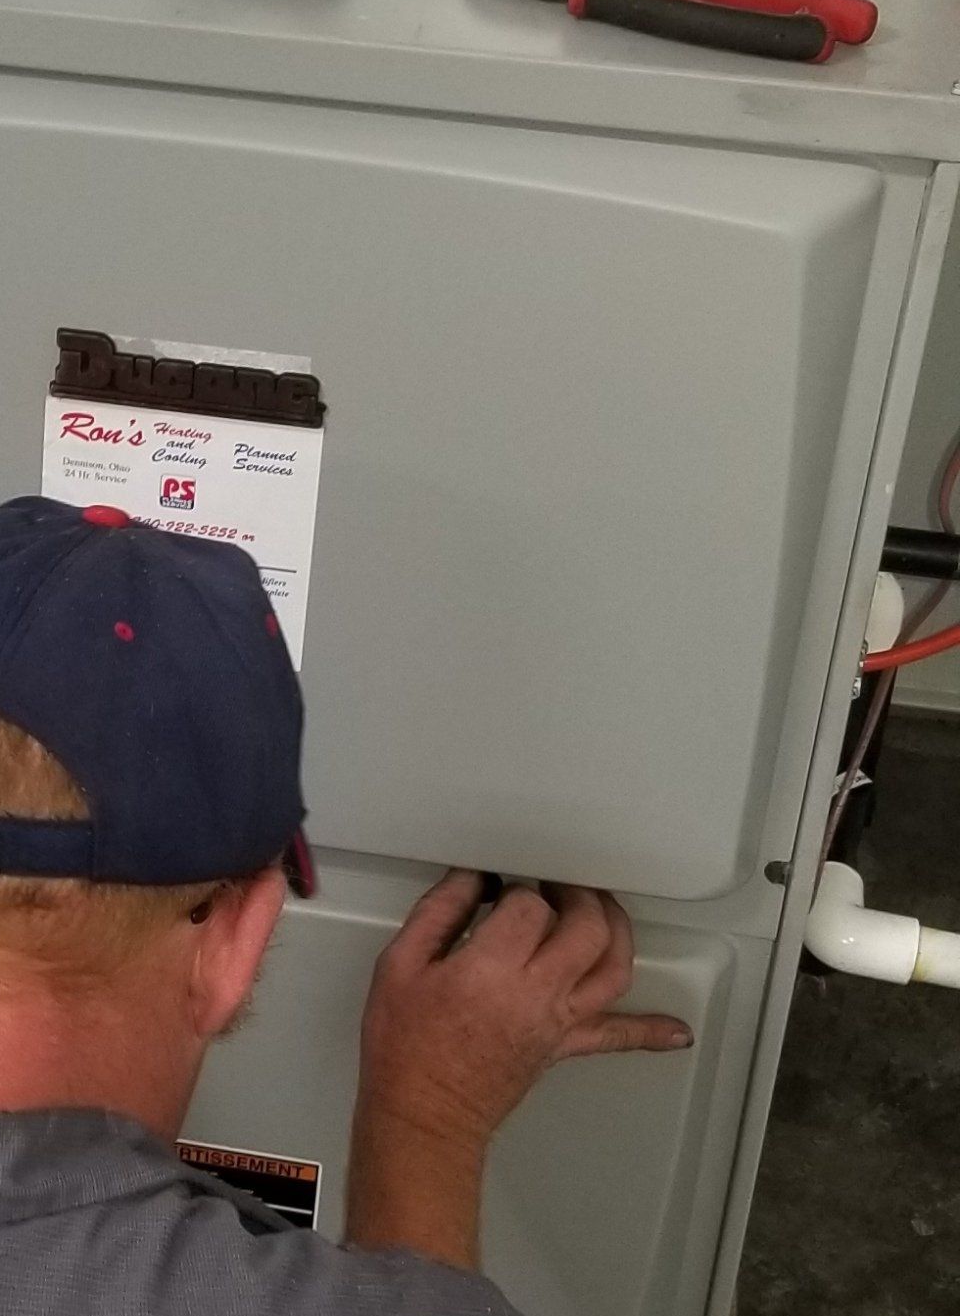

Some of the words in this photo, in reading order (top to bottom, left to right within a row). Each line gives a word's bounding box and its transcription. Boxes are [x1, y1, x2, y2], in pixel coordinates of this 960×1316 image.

[59, 412, 147, 446] Ron's
[153, 422, 212, 444] Heating
[166, 439, 196, 450] and
[233, 443, 298, 463] Planned
[151, 448, 208, 469] Cooling
[233, 458, 294, 476] Services
[64, 469, 76, 478] 24
[94, 472, 127, 484] Service
[163, 478, 196, 502] PS
[241, 534, 255, 542] or
[179, 1146, 305, 1179] RTISSEMENT
